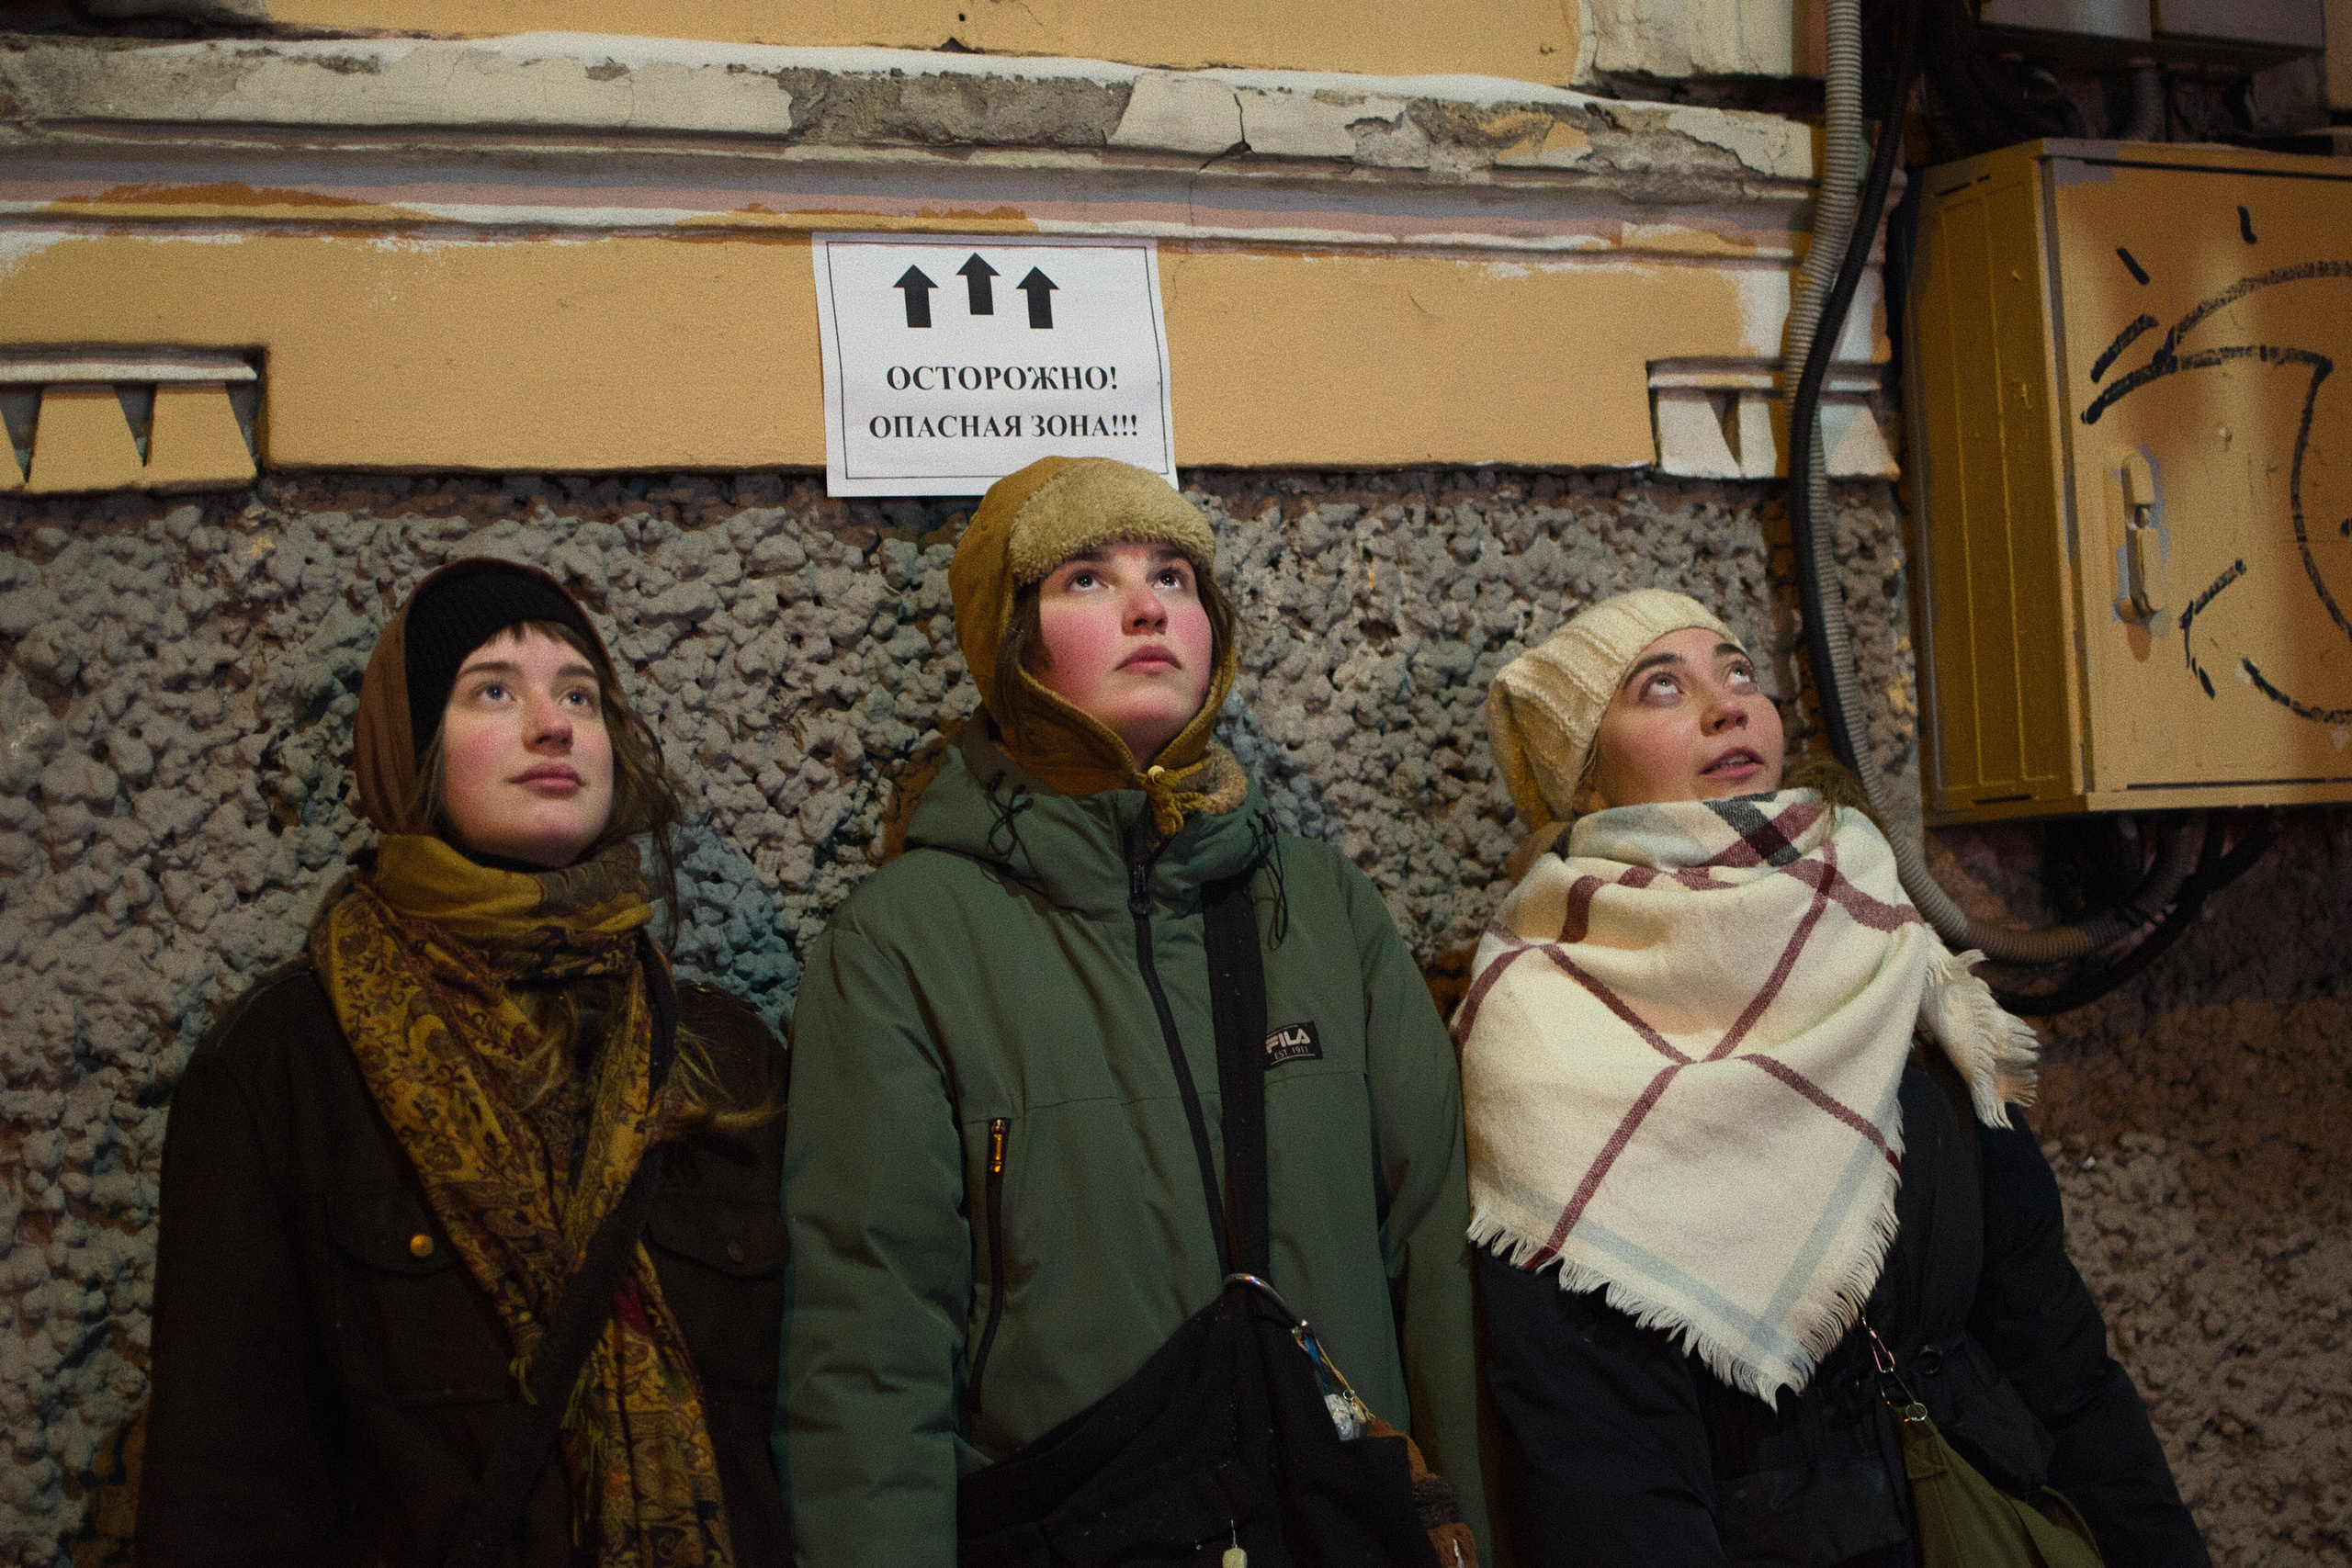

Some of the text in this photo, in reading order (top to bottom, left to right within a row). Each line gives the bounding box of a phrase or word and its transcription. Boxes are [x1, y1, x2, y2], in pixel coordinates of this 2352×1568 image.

[886, 366, 1118, 390] ОСТОРОЖНО!
[868, 414, 1138, 438] ОПАСНАЯ ЗОНА!!!
[1265, 1028, 1311, 1054] FILA
[1291, 1045, 1308, 1055] 1911
